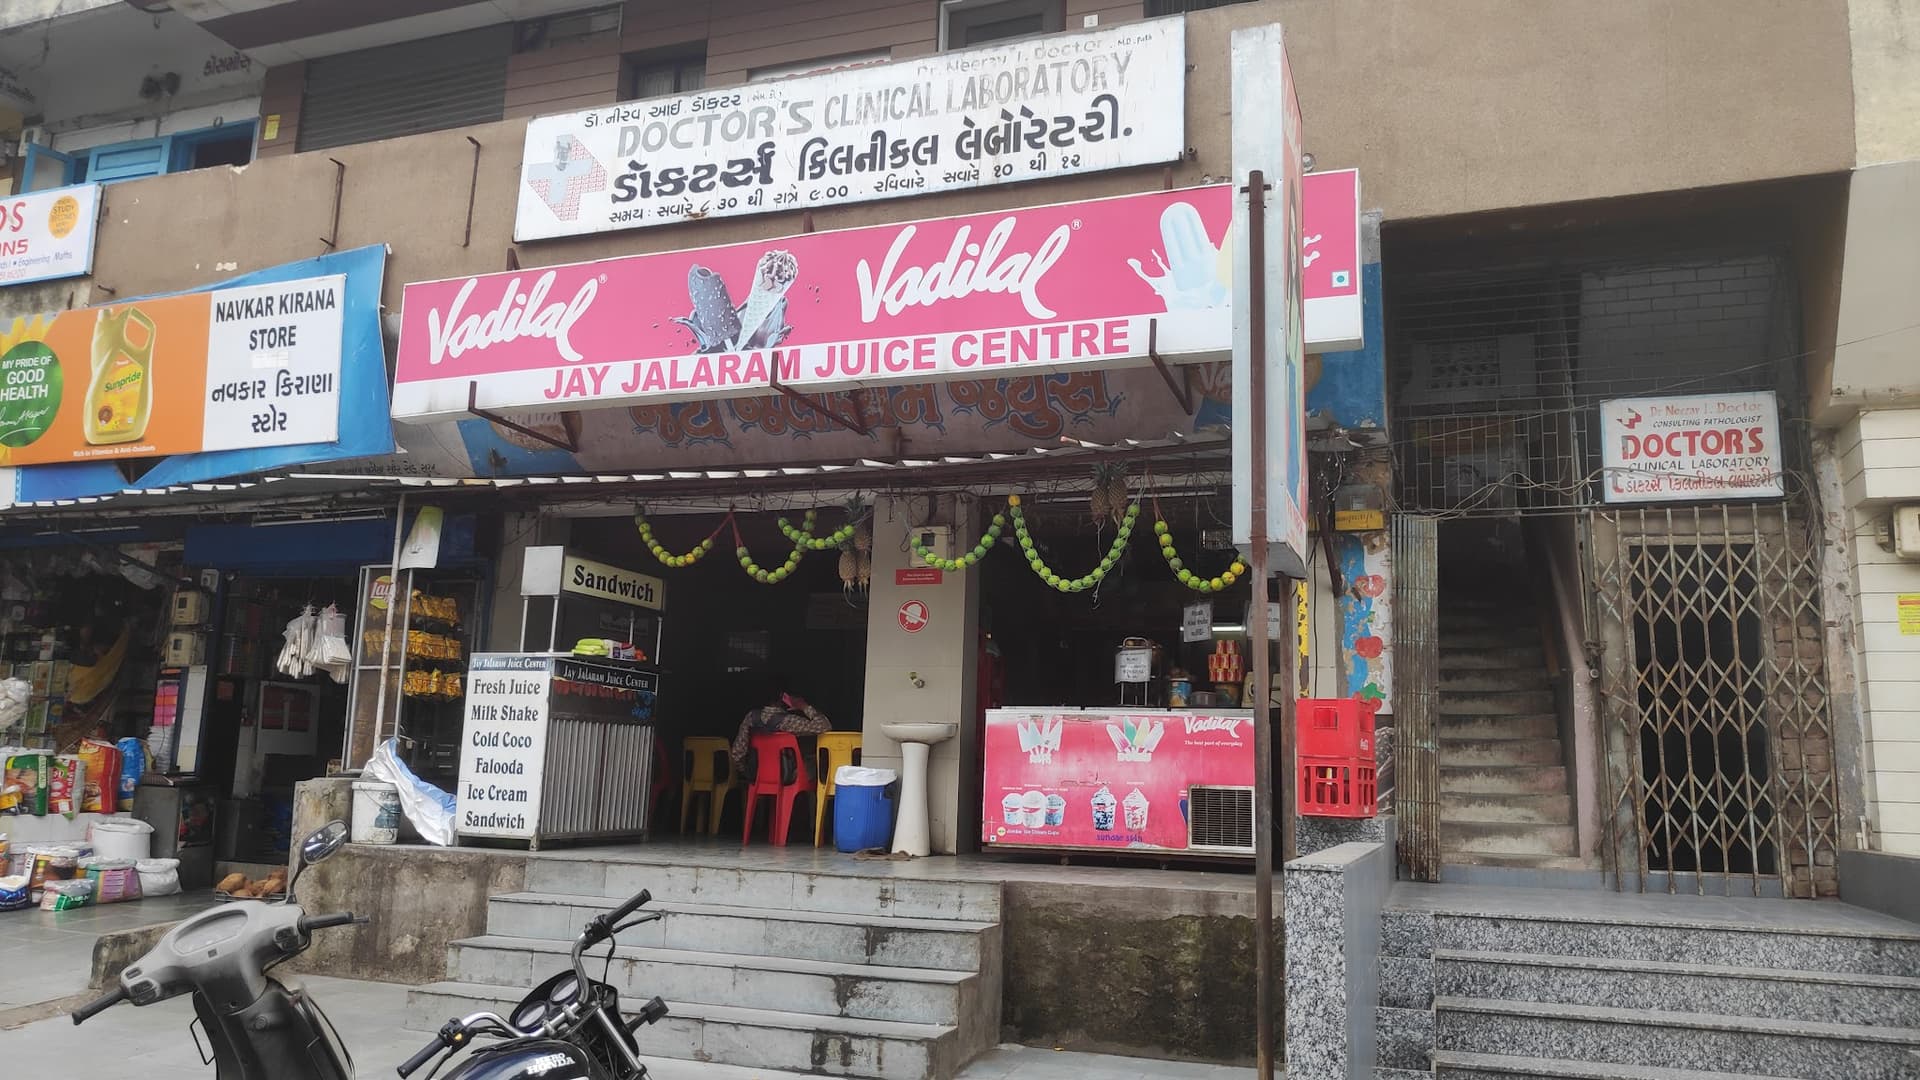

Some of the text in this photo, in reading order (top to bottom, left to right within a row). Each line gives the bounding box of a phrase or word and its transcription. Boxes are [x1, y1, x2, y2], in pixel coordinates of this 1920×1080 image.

[616, 100, 815, 159] DOCTOR'S
[823, 82, 939, 130] CLINICAL
[944, 50, 1133, 114] LABORATORY
[747, 189, 763, 207] થી
[873, 170, 925, 193] રવિવારે
[942, 163, 980, 184] સવારે
[1029, 152, 1047, 172] થી
[856, 216, 1071, 324] Vadilal
[215, 288, 336, 323] NAVKAR KIRANA
[428, 269, 599, 365] Vadilal
[249, 325, 297, 351] STORE
[2, 355, 53, 370] MY PRIDE OF
[544, 319, 1130, 400] JAY JALARAM JUICE CENTRE
[6, 368, 45, 385] GOOD
[211, 368, 333, 403] નવકાર કિરાણા
[0, 384, 49, 402] HEALTH
[251, 404, 287, 433] સ્ટોર
[1652, 415, 1763, 428] CONSULTING PATHOLOGIST
[1621, 427, 1764, 460] DOCTOR'S
[1629, 456, 1770, 472] CLINICAL LABORATORY
[573, 564, 655, 603] Sandwich
[473, 678, 506, 695] Fresh
[509, 679, 541, 696] Juice
[471, 704, 539, 722] Milk Shake
[472, 731, 533, 749] Cold Coco
[475, 757, 524, 776] Falooda
[467, 783, 528, 803] Ice Cream
[465, 810, 525, 830] Sandwich
[526, 1056, 576, 1075] HONDA
